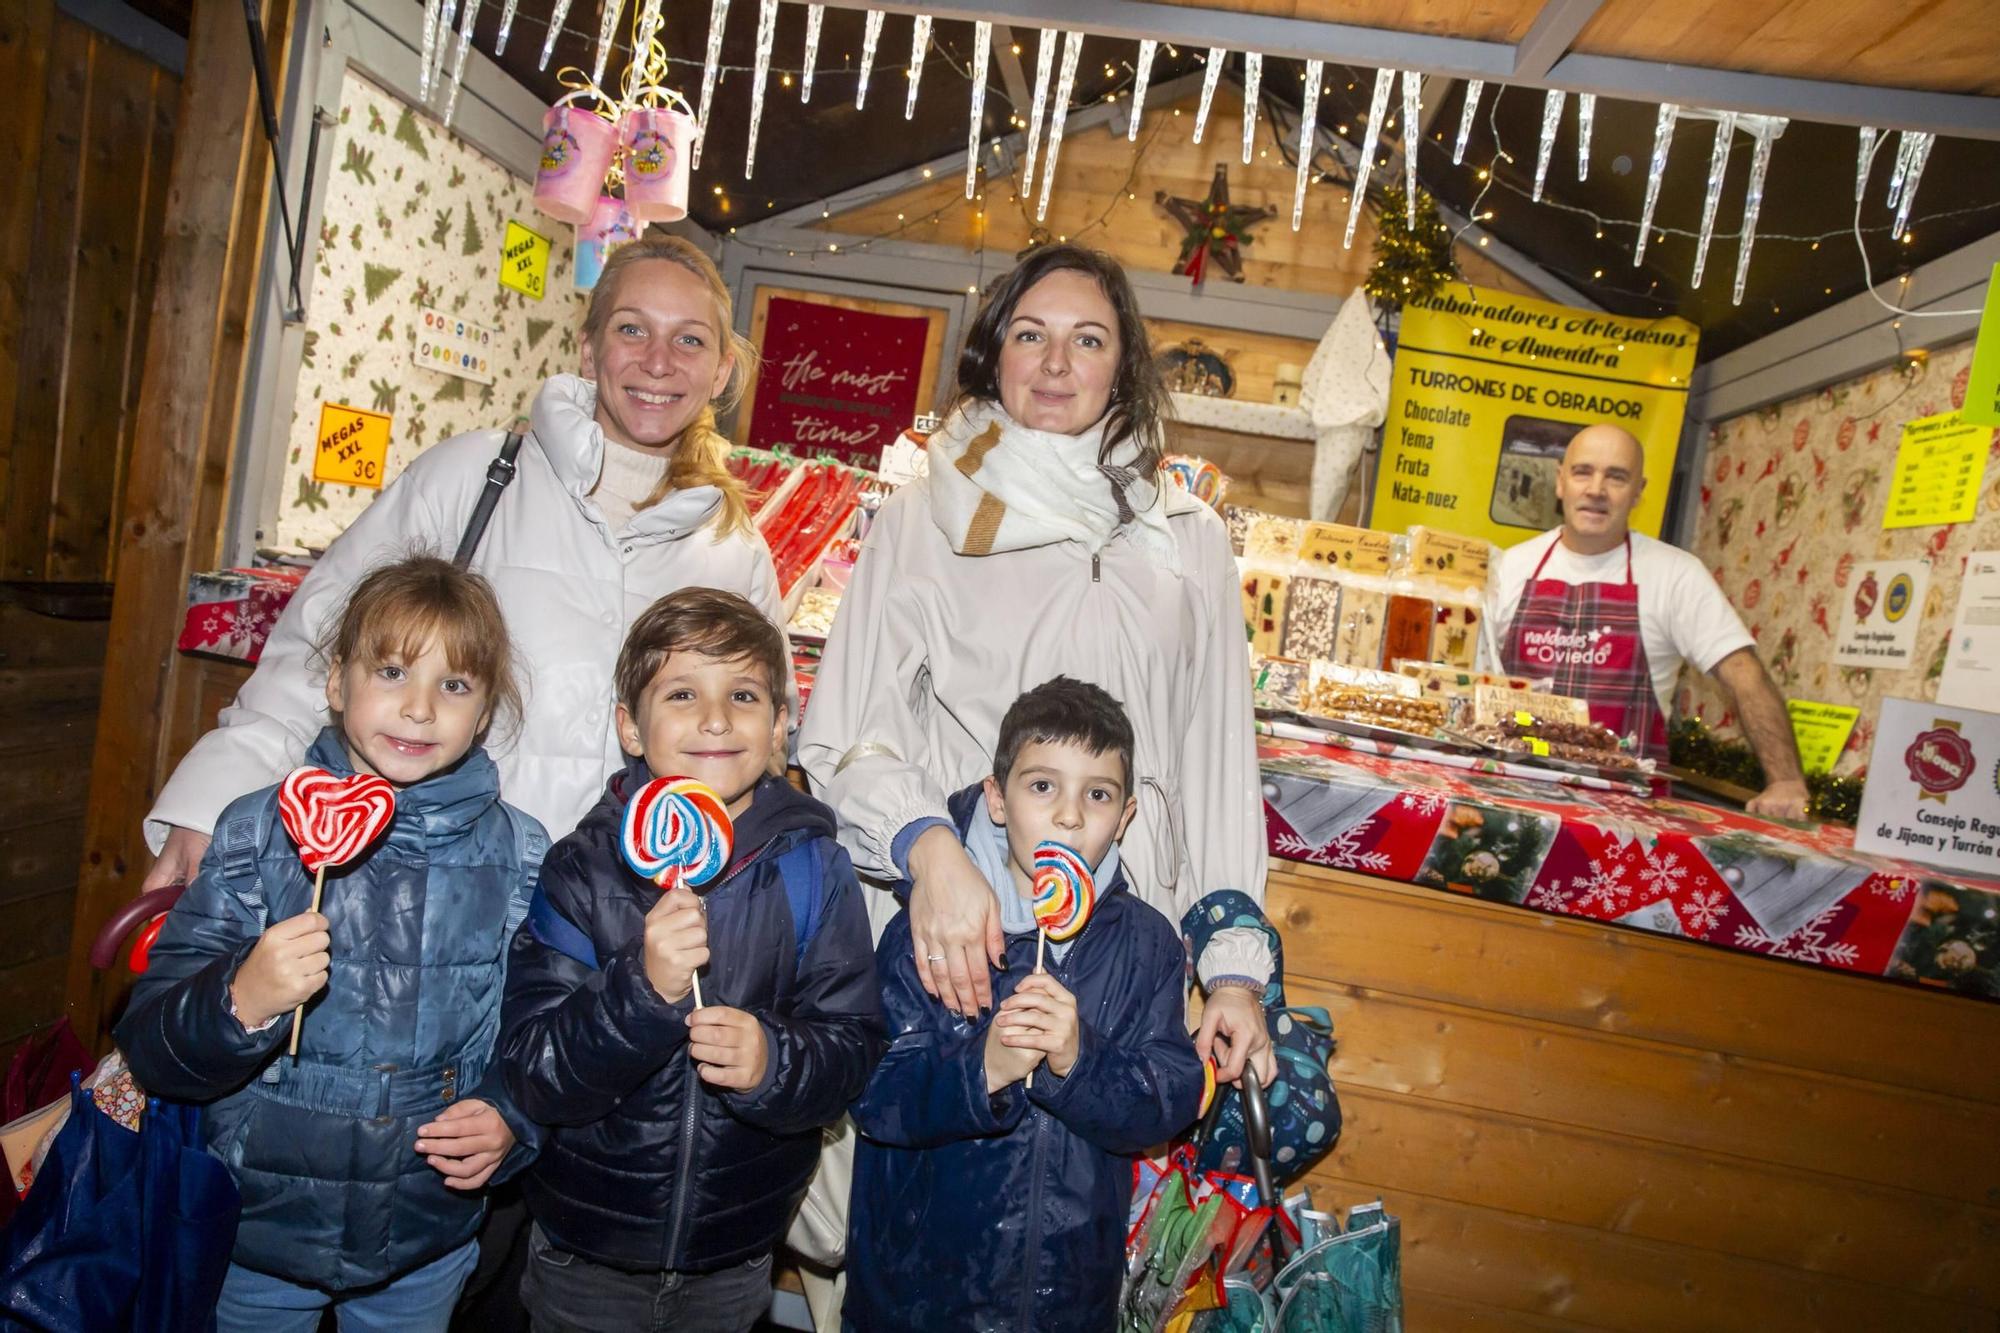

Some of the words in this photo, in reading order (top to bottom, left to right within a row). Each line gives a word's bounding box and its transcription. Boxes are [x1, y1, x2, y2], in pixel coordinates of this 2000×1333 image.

[506, 236, 535, 262] MEGAS
[517, 256, 533, 272] XXL
[1564, 319, 1688, 348] Artesanos
[1469, 329, 1497, 349] de
[1500, 336, 1620, 369] Almendra
[782, 350, 827, 391] the
[831, 371, 907, 396] most
[1409, 368, 1506, 399] TURRONES
[1511, 384, 1538, 405] DE
[1543, 391, 1644, 420] OBRADOR
[1404, 400, 1471, 427] Chocolate
[321, 417, 365, 453] MEGAS
[792, 415, 880, 445] time
[1400, 427, 1435, 451] Yema
[337, 440, 362, 464] XXL
[1395, 454, 1431, 477] Fruta
[1391, 480, 1458, 510] Nata-nuez
[1538, 645, 1608, 665] Oviedo
[1916, 808, 1967, 833] Consejo
[1877, 822, 1893, 839] de
[1896, 826, 1934, 847] Jijona
[1938, 838, 1947, 852] y
[1951, 835, 1993, 857] Turrón
